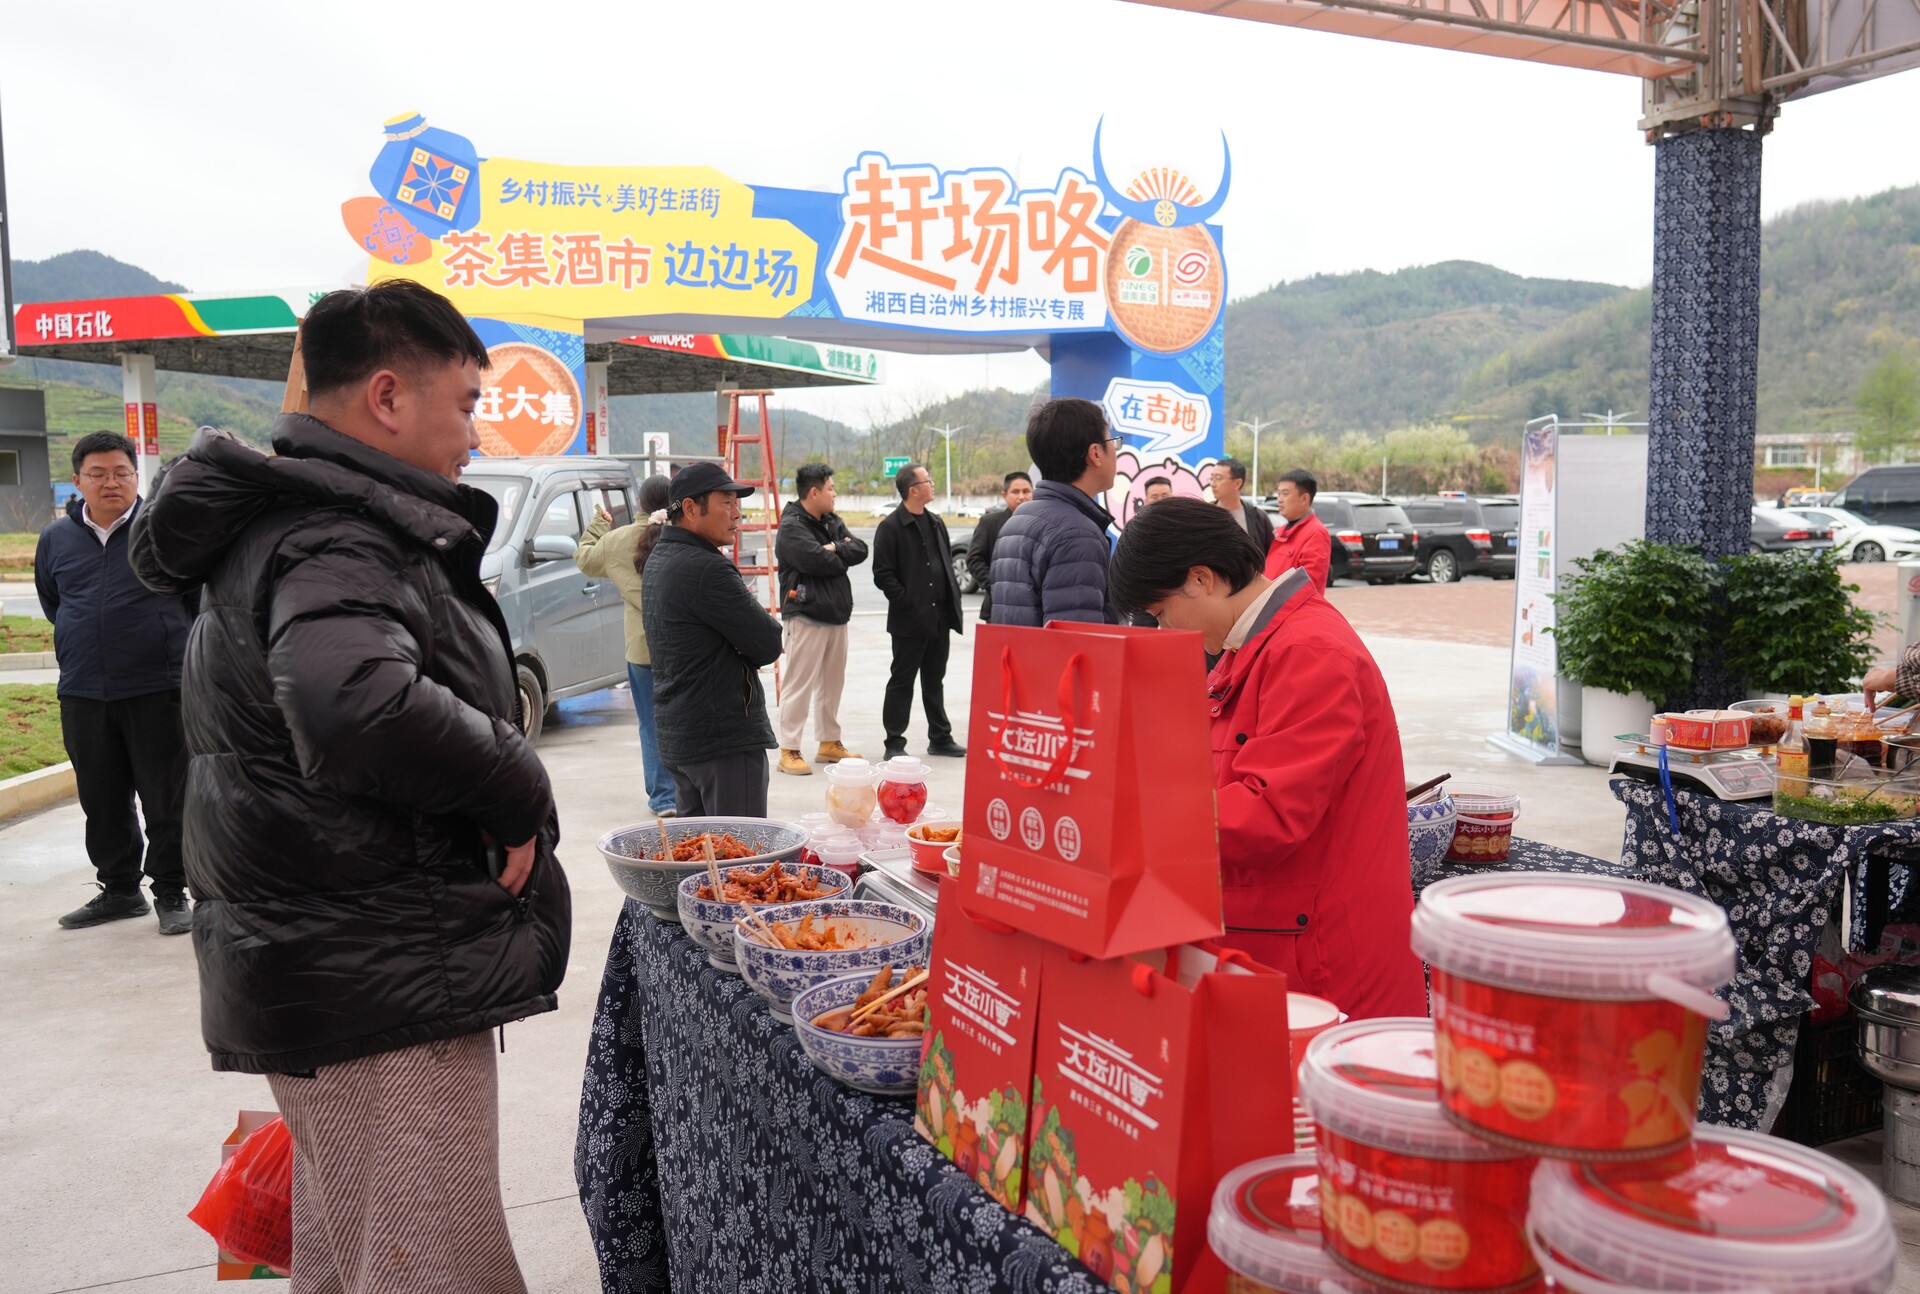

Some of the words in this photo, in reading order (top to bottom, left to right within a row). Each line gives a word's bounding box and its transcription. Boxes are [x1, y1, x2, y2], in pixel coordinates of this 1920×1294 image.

[834, 163, 1109, 294] 赶场咯
[442, 231, 651, 289] 茶集酒市
[664, 241, 797, 297] 边边场
[35, 310, 114, 340] 中国石化
[865, 290, 1085, 321] 湘西自治州乡村振兴专展
[1120, 393, 1197, 432] 在吉地
